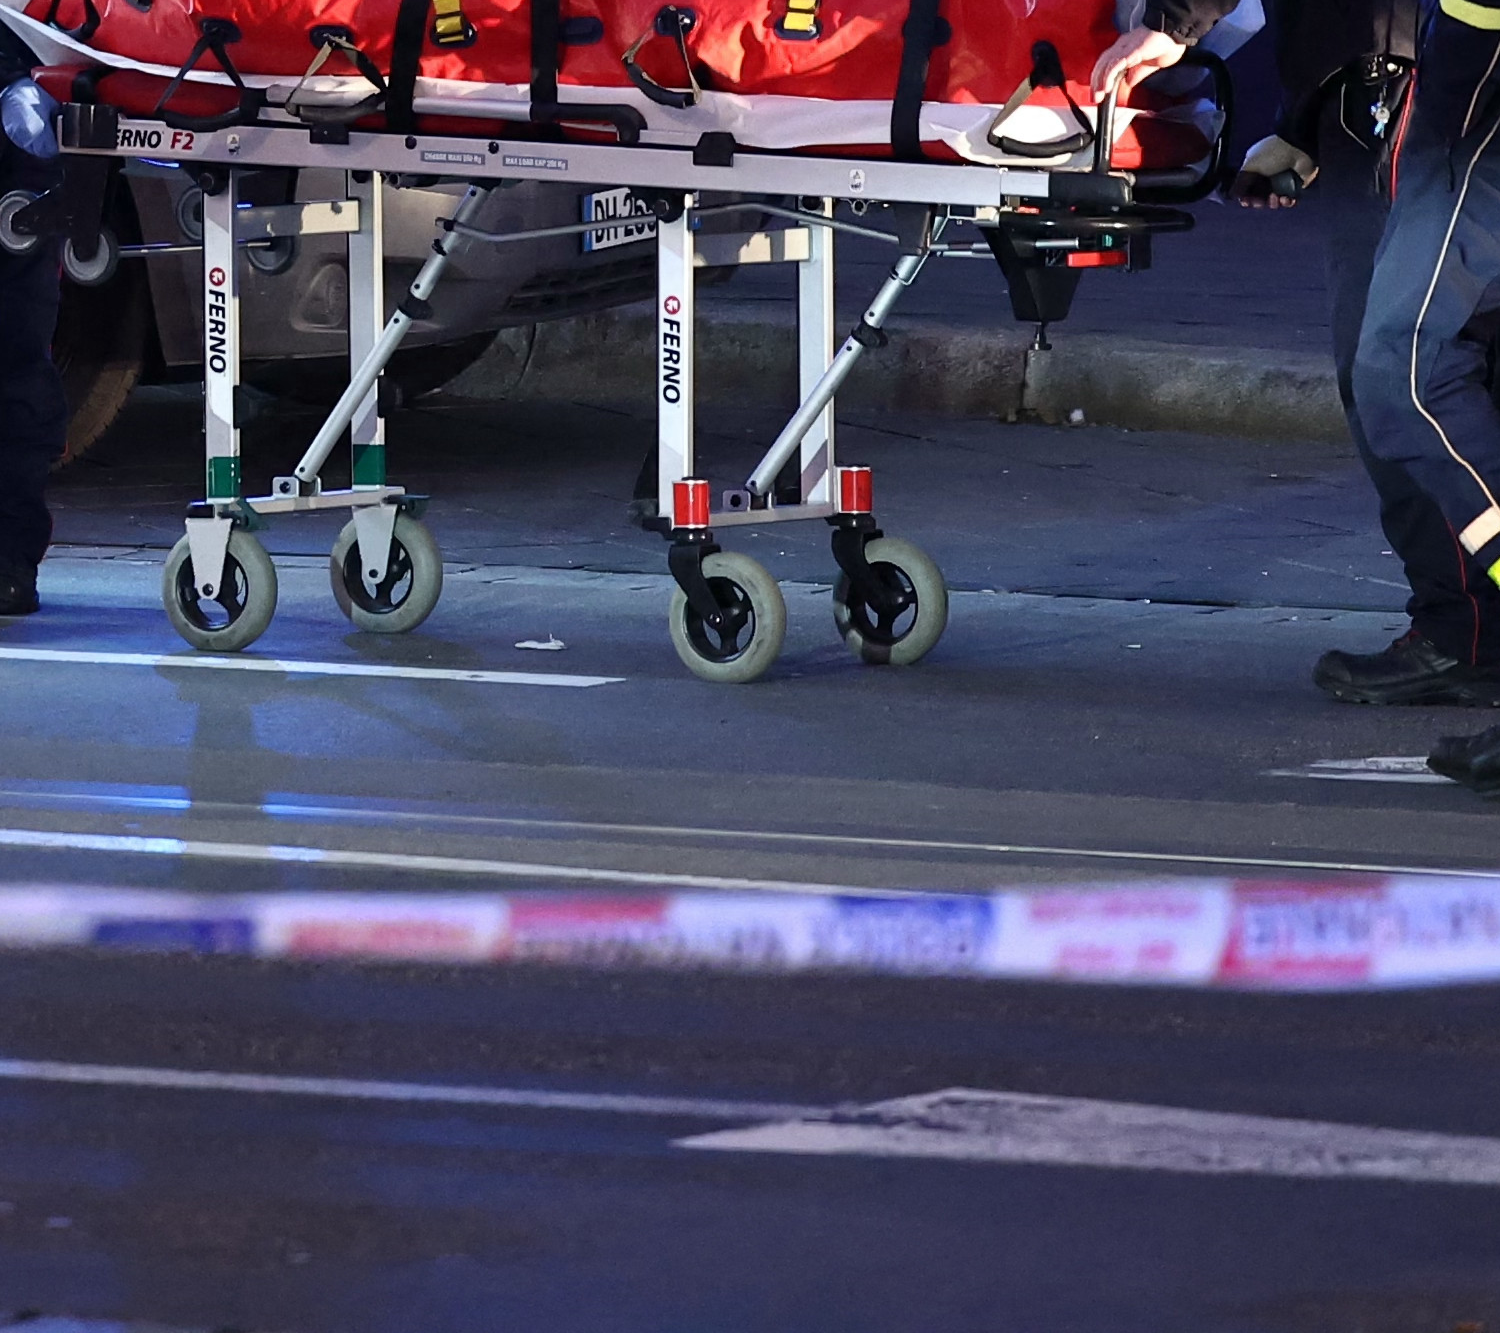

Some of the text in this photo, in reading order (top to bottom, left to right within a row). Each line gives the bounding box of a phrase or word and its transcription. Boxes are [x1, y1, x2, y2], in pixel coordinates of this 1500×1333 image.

[116, 128, 195, 150] ERNO F2
[208, 288, 227, 374] FERNO
[662, 317, 681, 405] FERNO
